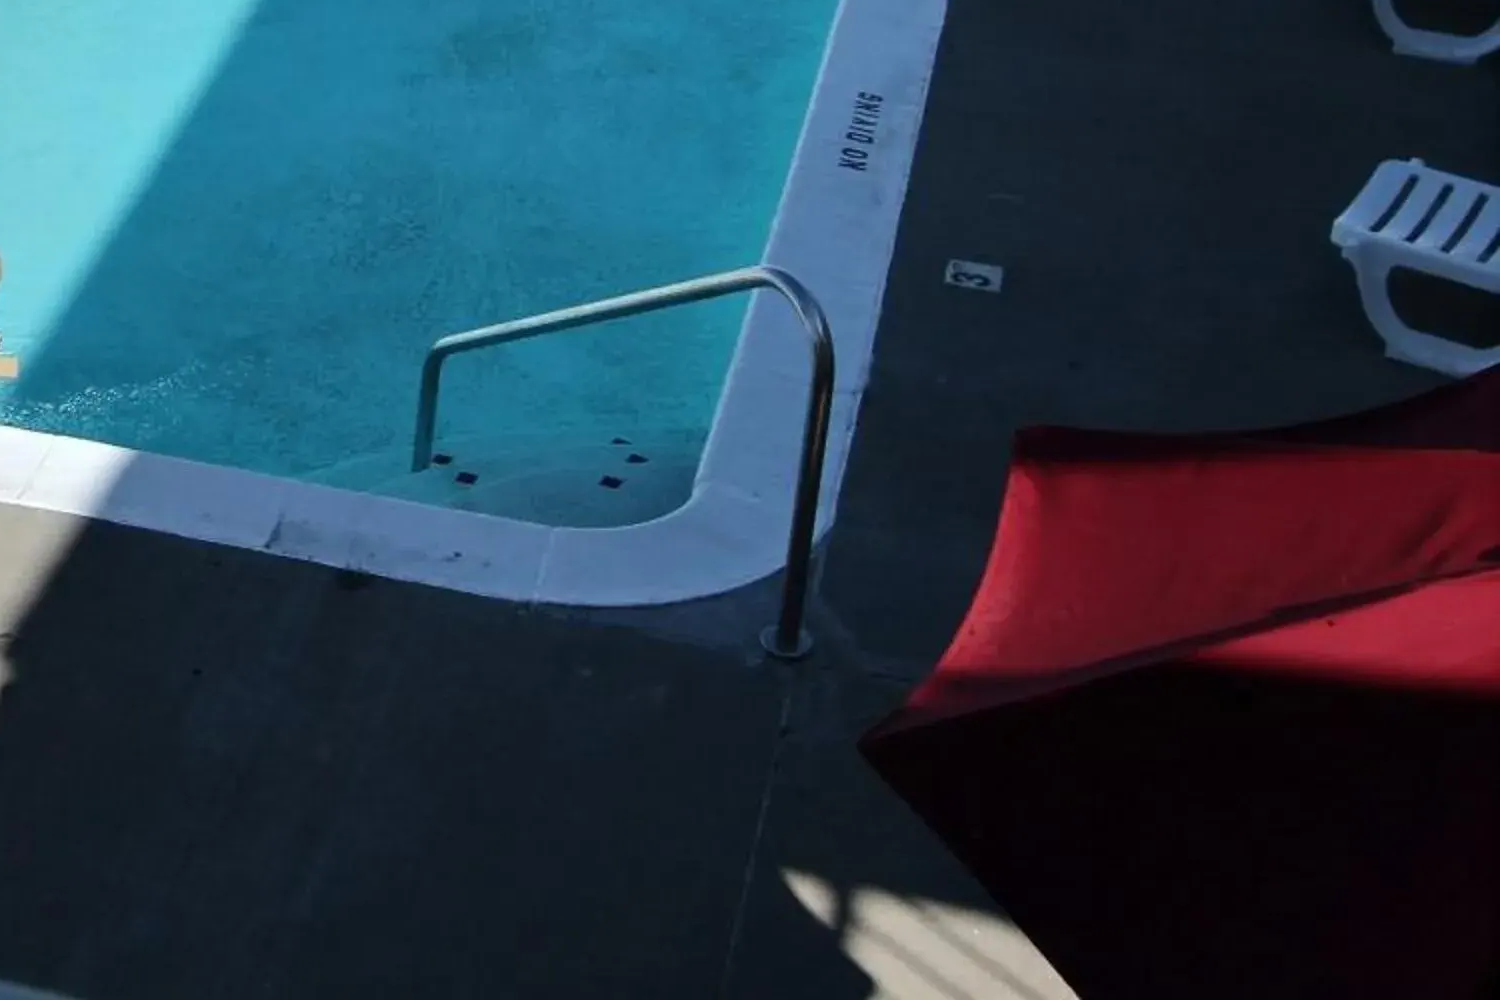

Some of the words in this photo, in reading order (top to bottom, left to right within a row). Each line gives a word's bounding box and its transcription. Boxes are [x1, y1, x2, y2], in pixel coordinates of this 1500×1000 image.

[845, 91, 884, 144] DIVING
[837, 147, 869, 172] NO
[950, 271, 992, 288] 3
